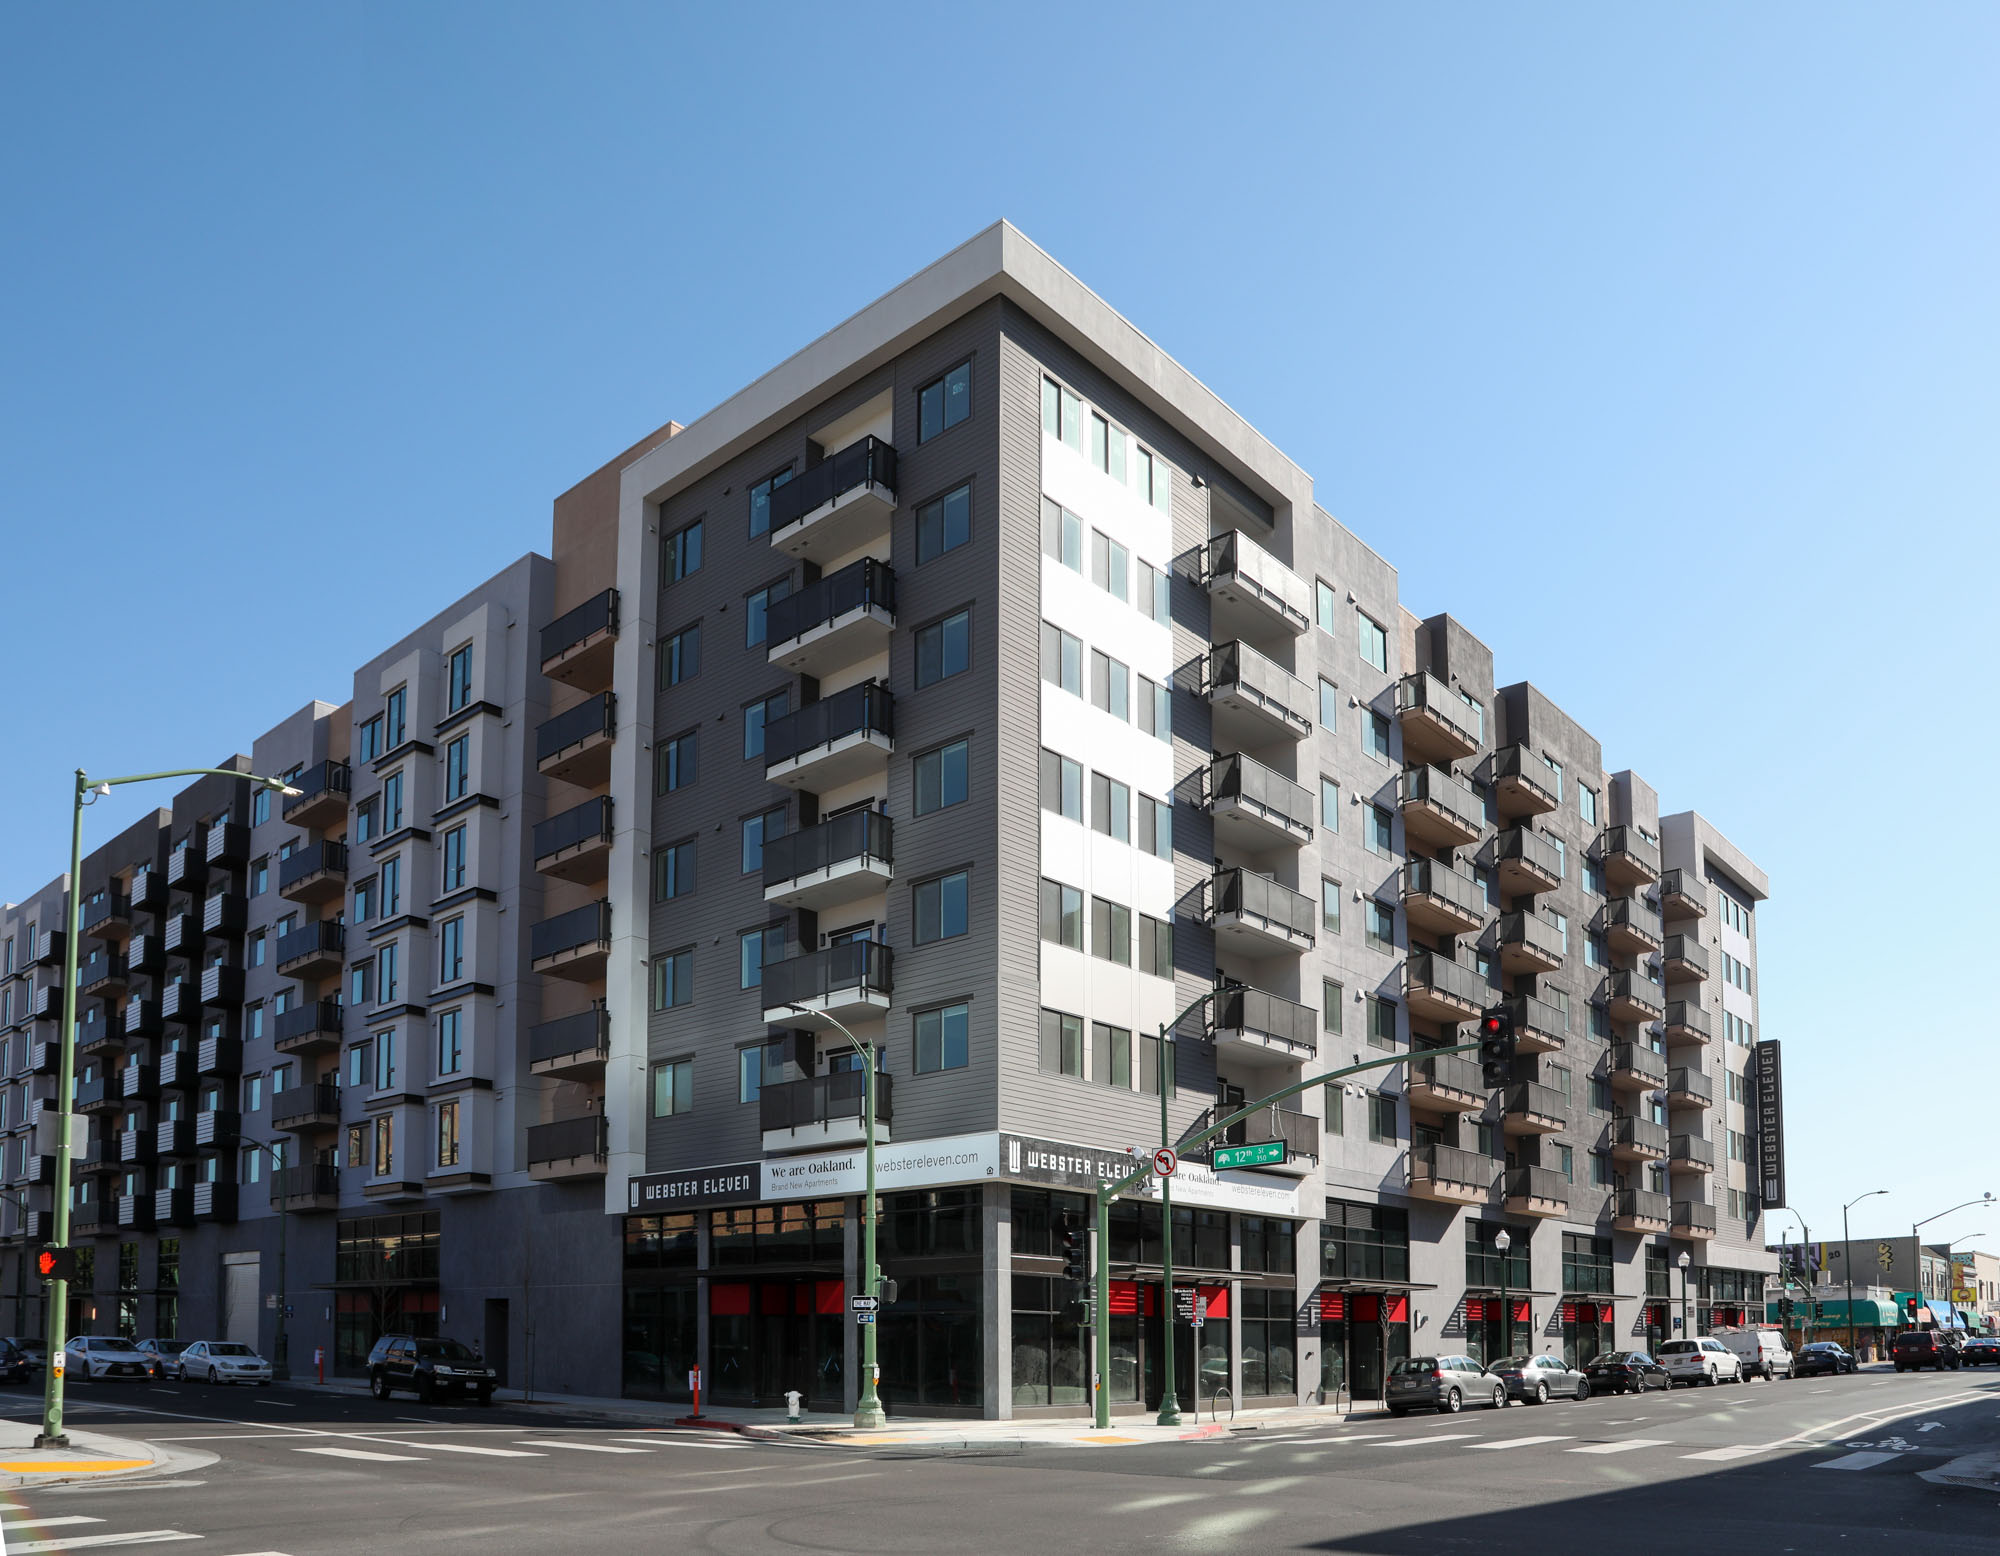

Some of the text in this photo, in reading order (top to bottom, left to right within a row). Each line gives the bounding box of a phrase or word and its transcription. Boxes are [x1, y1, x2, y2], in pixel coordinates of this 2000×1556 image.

[1762, 1047, 1774, 1102] ELEVEN
[1764, 1107, 1777, 1176] WEBSTER
[875, 1152, 979, 1173] webstereleven.com
[1027, 1151, 1091, 1175] WEBSTER
[1098, 1161, 1143, 1180] ELEV
[1235, 1150, 1253, 1163] 12th
[771, 1158, 856, 1178] We are Oakland.
[646, 1181, 698, 1199] WEBSTER
[704, 1175, 749, 1194] ELEVEN
[771, 1177, 838, 1192] Brand New Apartments
[1231, 1183, 1290, 1201] webstereleven.com
